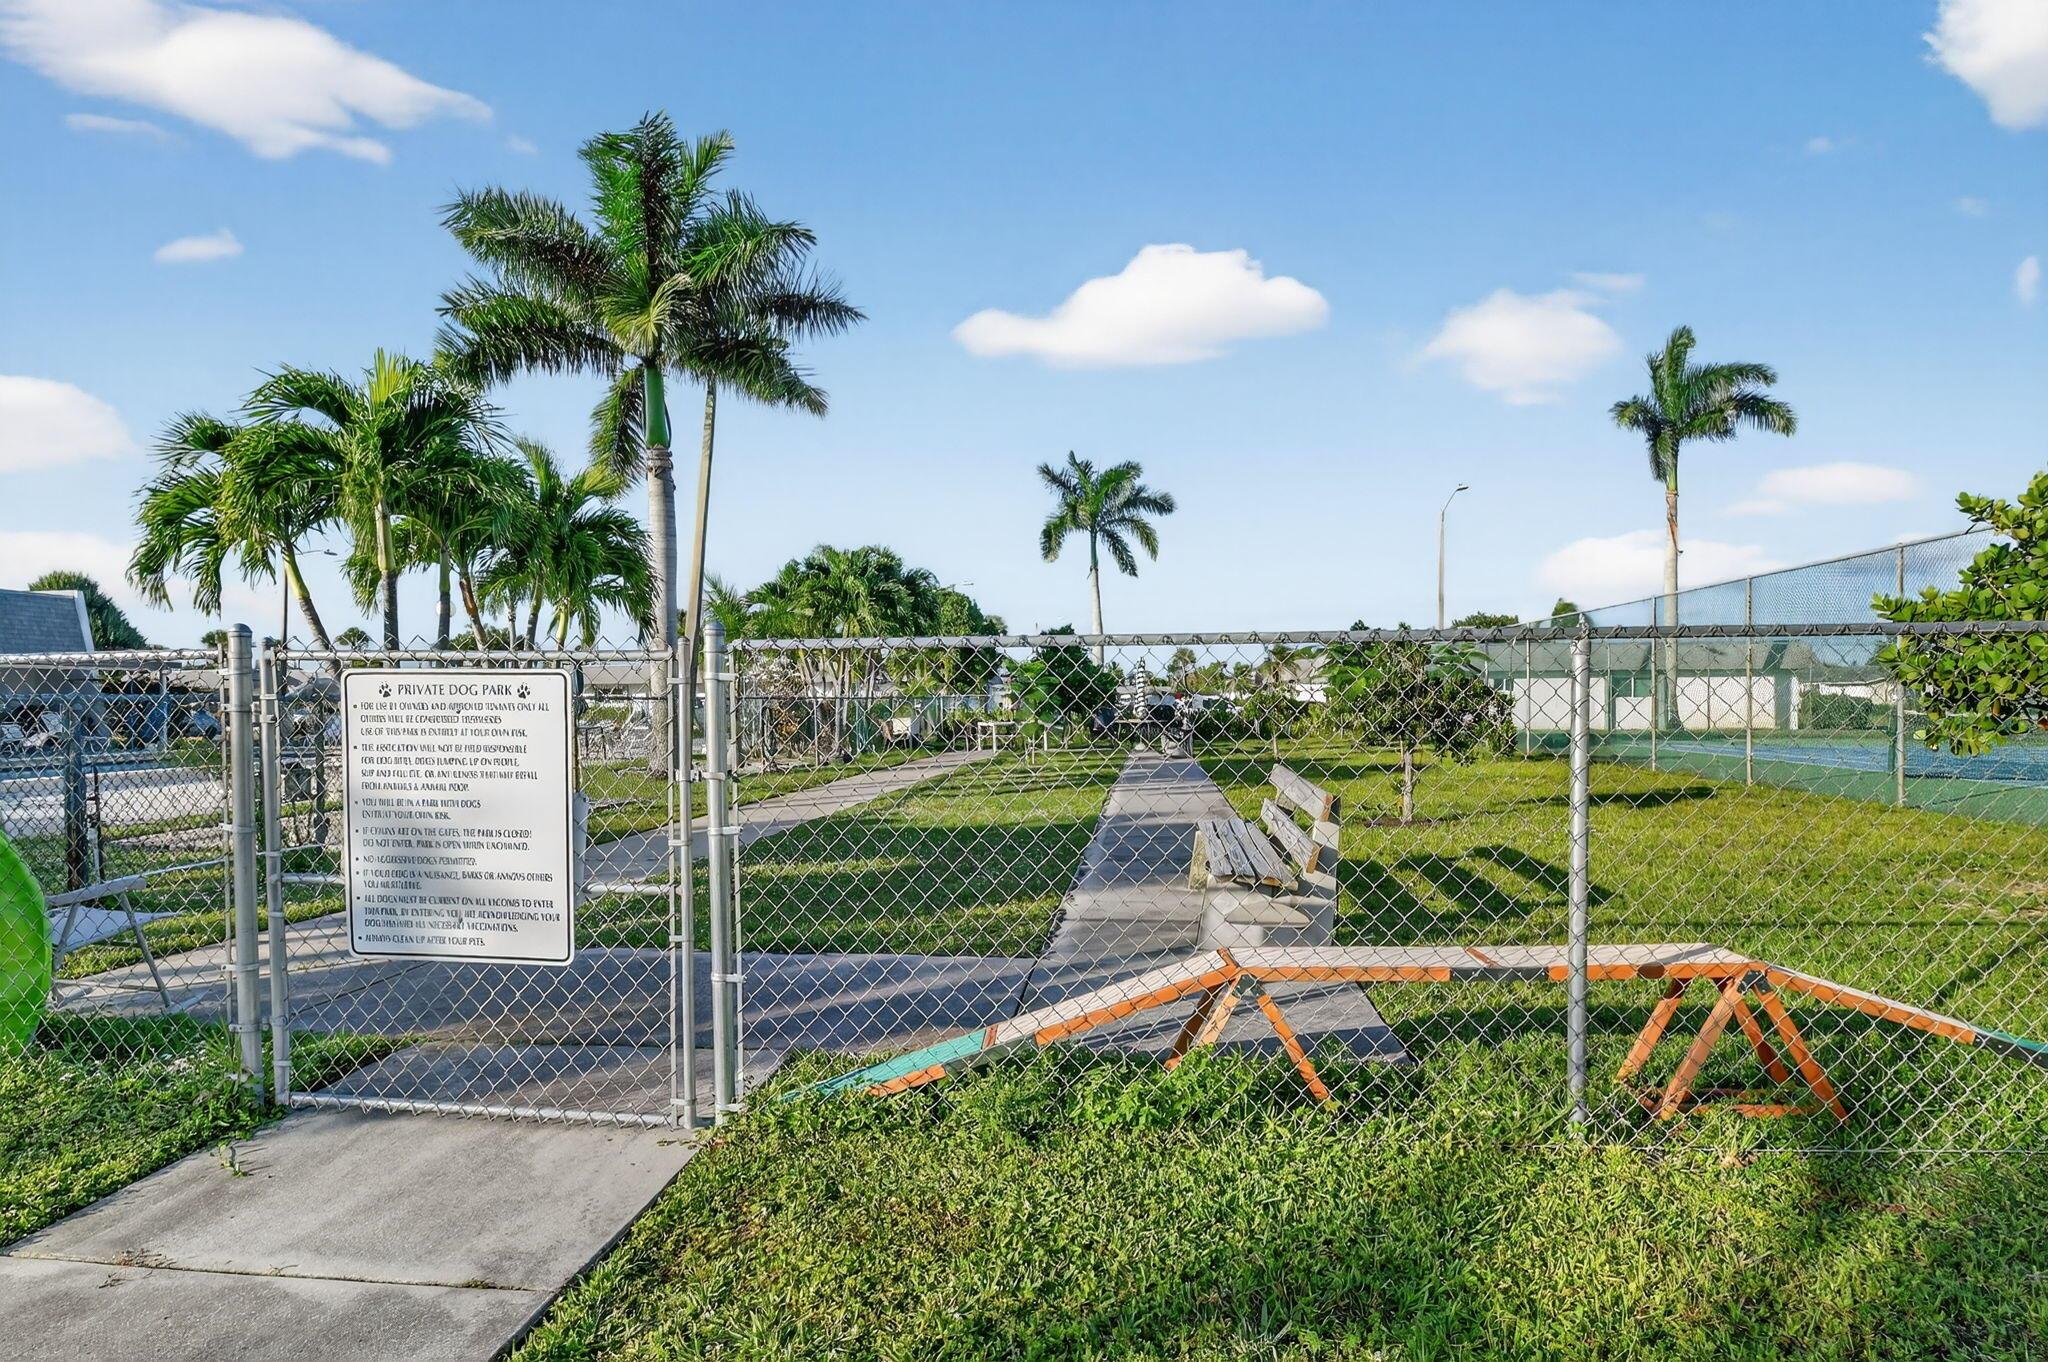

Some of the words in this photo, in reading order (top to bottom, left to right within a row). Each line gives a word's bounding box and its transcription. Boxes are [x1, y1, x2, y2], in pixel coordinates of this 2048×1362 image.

[397, 684, 445, 696] PRIVATE
[449, 684, 478, 696] DOG
[482, 684, 512, 696] PARK
